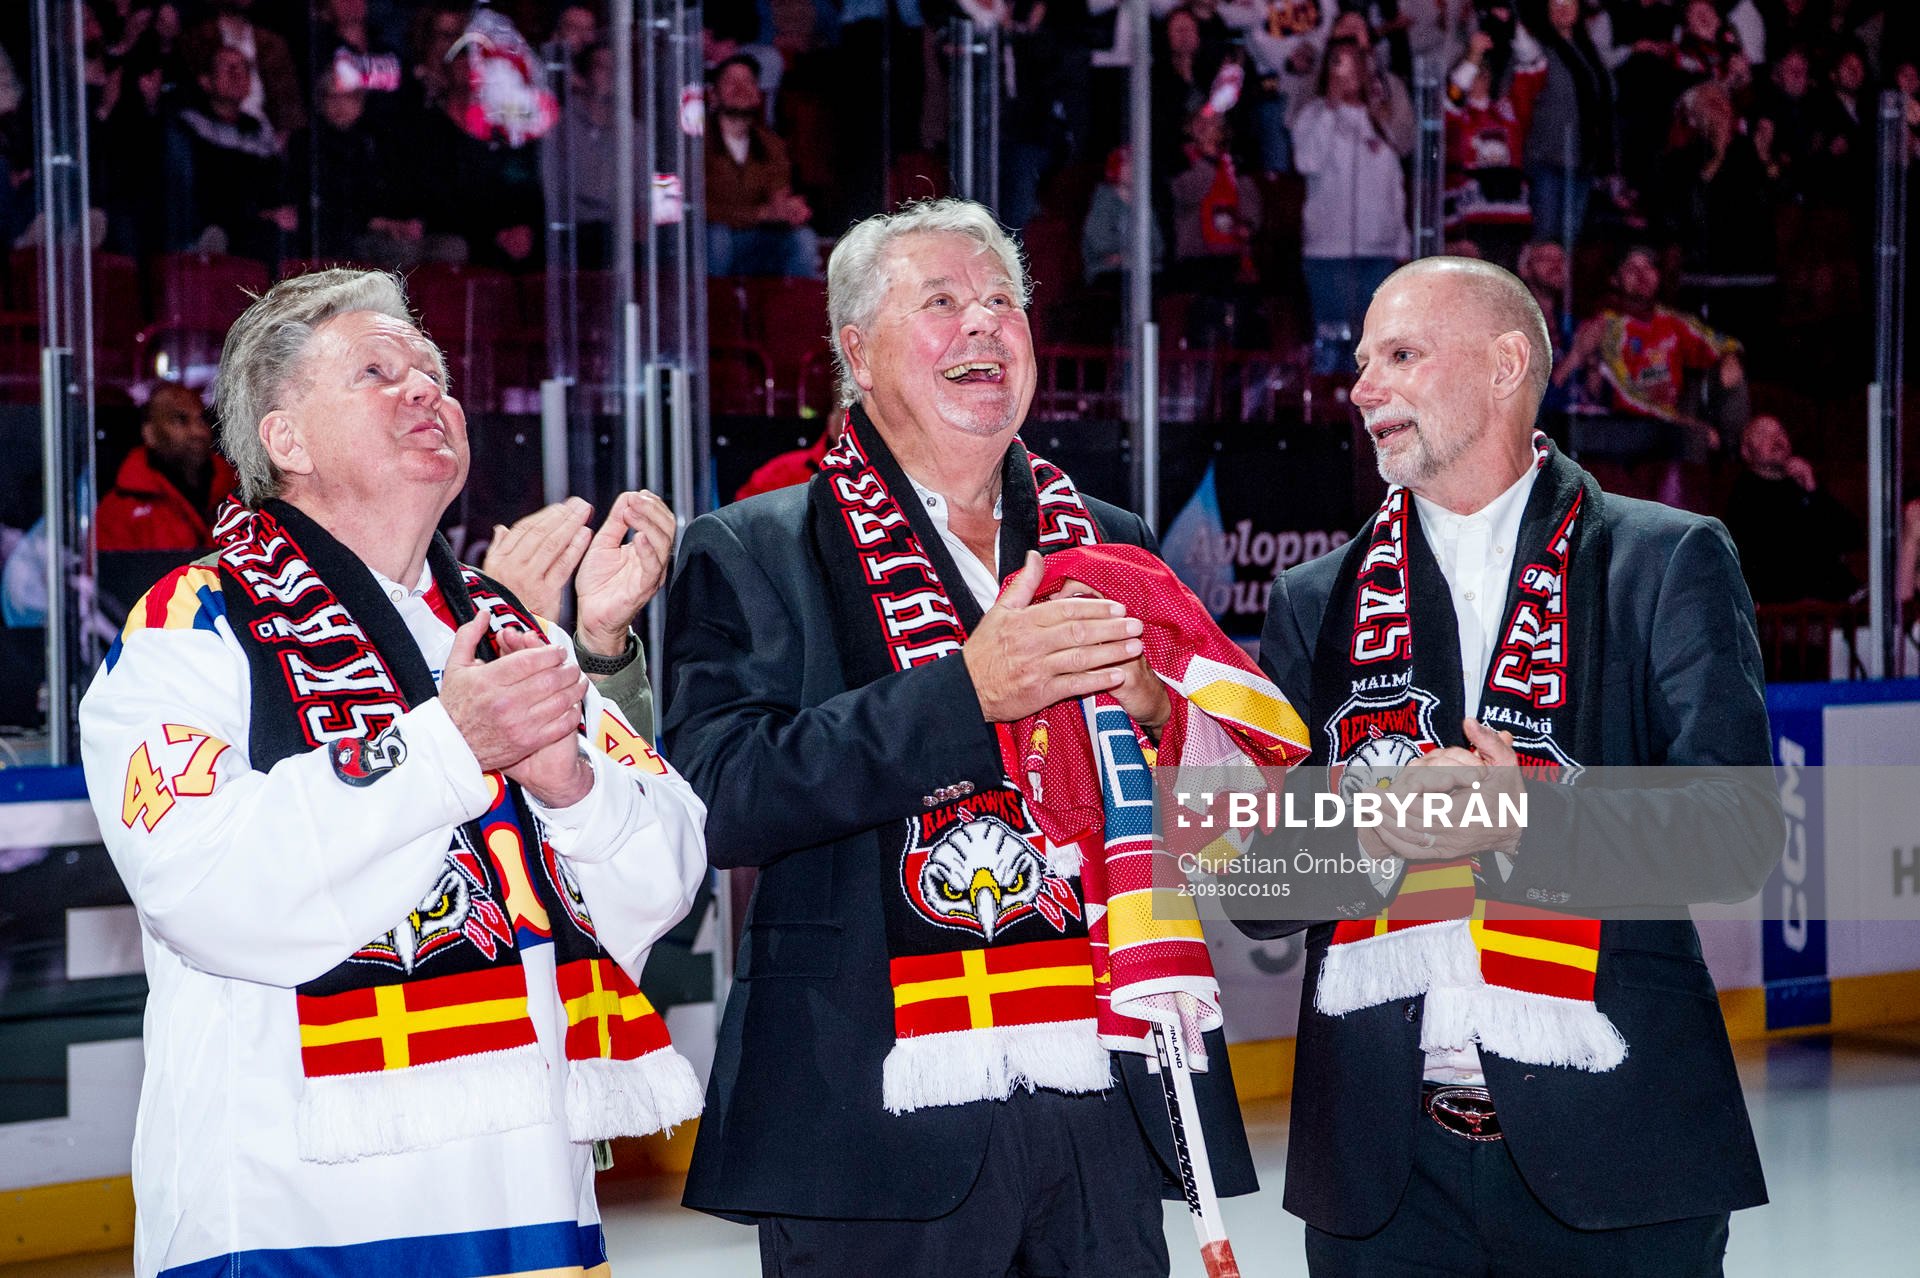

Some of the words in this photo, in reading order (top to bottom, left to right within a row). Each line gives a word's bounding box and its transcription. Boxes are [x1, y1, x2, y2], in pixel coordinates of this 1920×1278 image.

[1481, 705, 1553, 735] MALMÖ
[121, 723, 231, 833] 47
[1778, 735, 1808, 953] CCM
[1168, 1024, 1183, 1069] FINLAND
